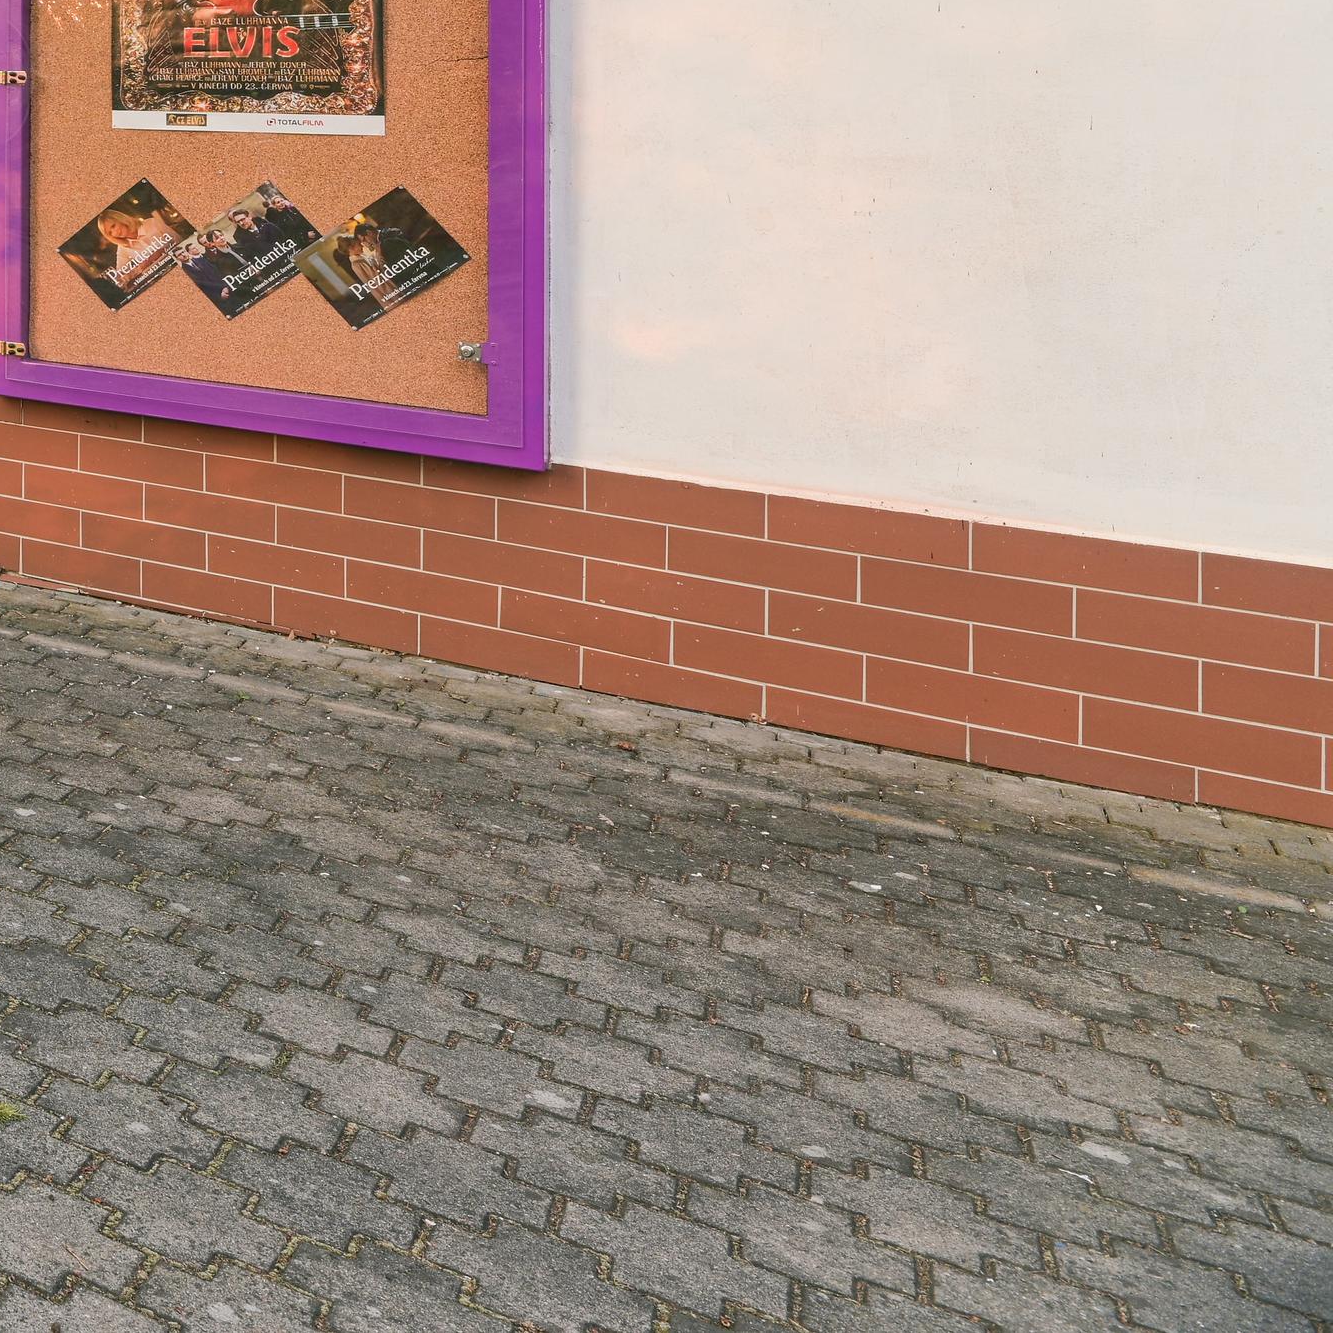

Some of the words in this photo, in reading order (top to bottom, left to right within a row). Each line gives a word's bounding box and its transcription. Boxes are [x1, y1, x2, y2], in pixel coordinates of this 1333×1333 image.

[210, 17, 232, 26] BAZE
[235, 17, 289, 26] LUHRMANNA
[183, 26, 301, 58] ELVIS
[298, 68, 341, 76] LUHRMANN
[210, 74, 238, 82] JEREMY
[198, 82, 228, 90] KINECH
[230, 82, 242, 90] OD
[261, 81, 293, 90] ČERVNA
[277, 119, 324, 127] TOTALFILM
[106, 232, 173, 285] Prezidentka
[222, 238, 297, 291] Prezidentka
[349, 246, 430, 301] Prezidentka
